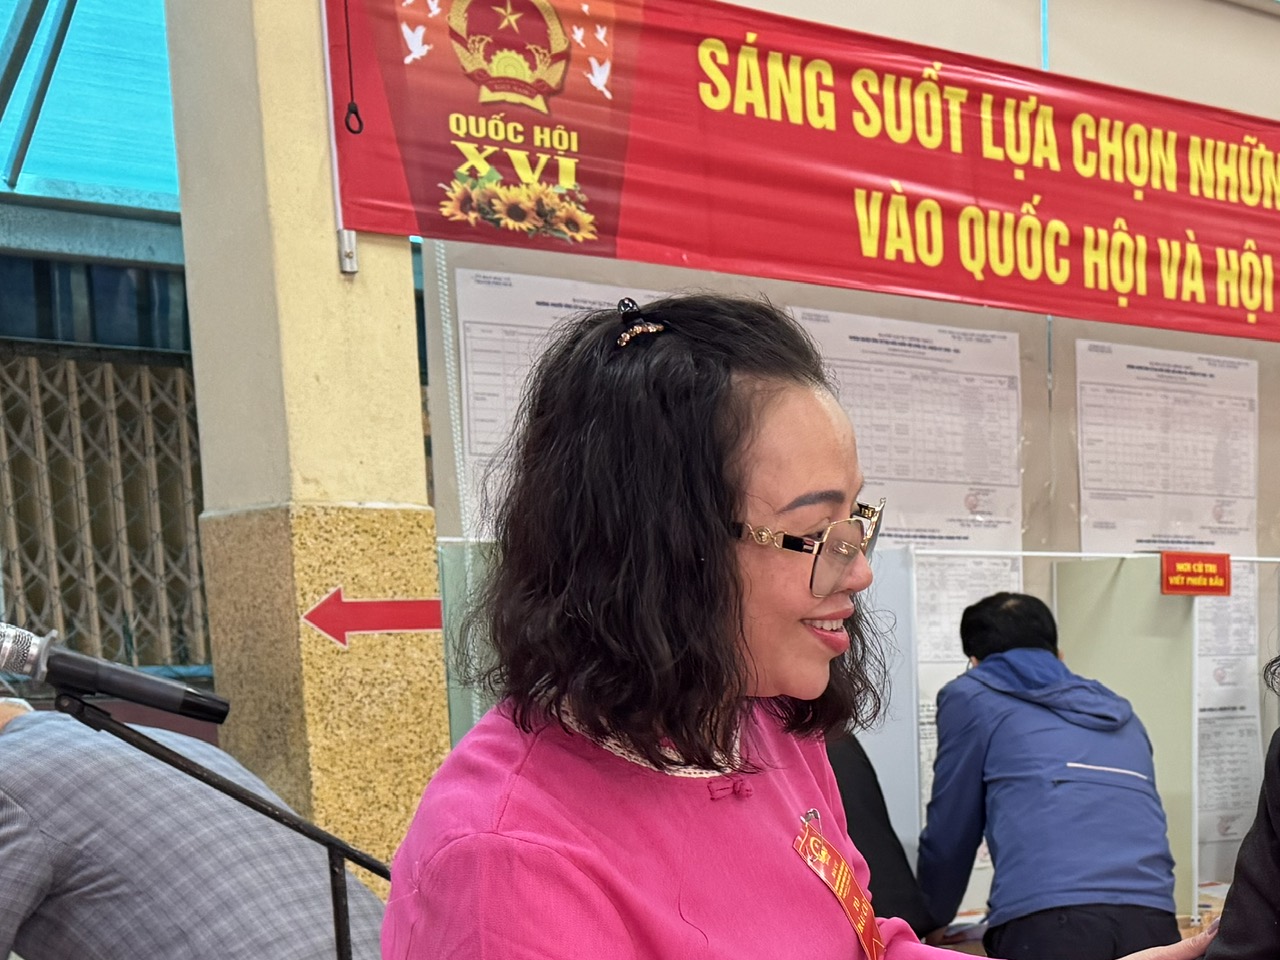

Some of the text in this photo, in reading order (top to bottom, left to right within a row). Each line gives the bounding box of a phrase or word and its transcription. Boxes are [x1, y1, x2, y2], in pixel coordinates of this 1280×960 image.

[448, 112, 579, 155] QUỐC HỘI
[450, 140, 580, 190] XVI
[697, 32, 836, 131] SÁNG
[851, 61, 969, 154] SUỐT
[981, 93, 1061, 180] LỰA
[1071, 113, 1177, 201] CHỌN
[854, 179, 944, 267] VÀO
[958, 194, 1070, 285] QUỐC
[1083, 217, 1147, 307] HỘI
[1157, 229, 1206, 304] VÀ
[1215, 239, 1274, 324] HỘI
